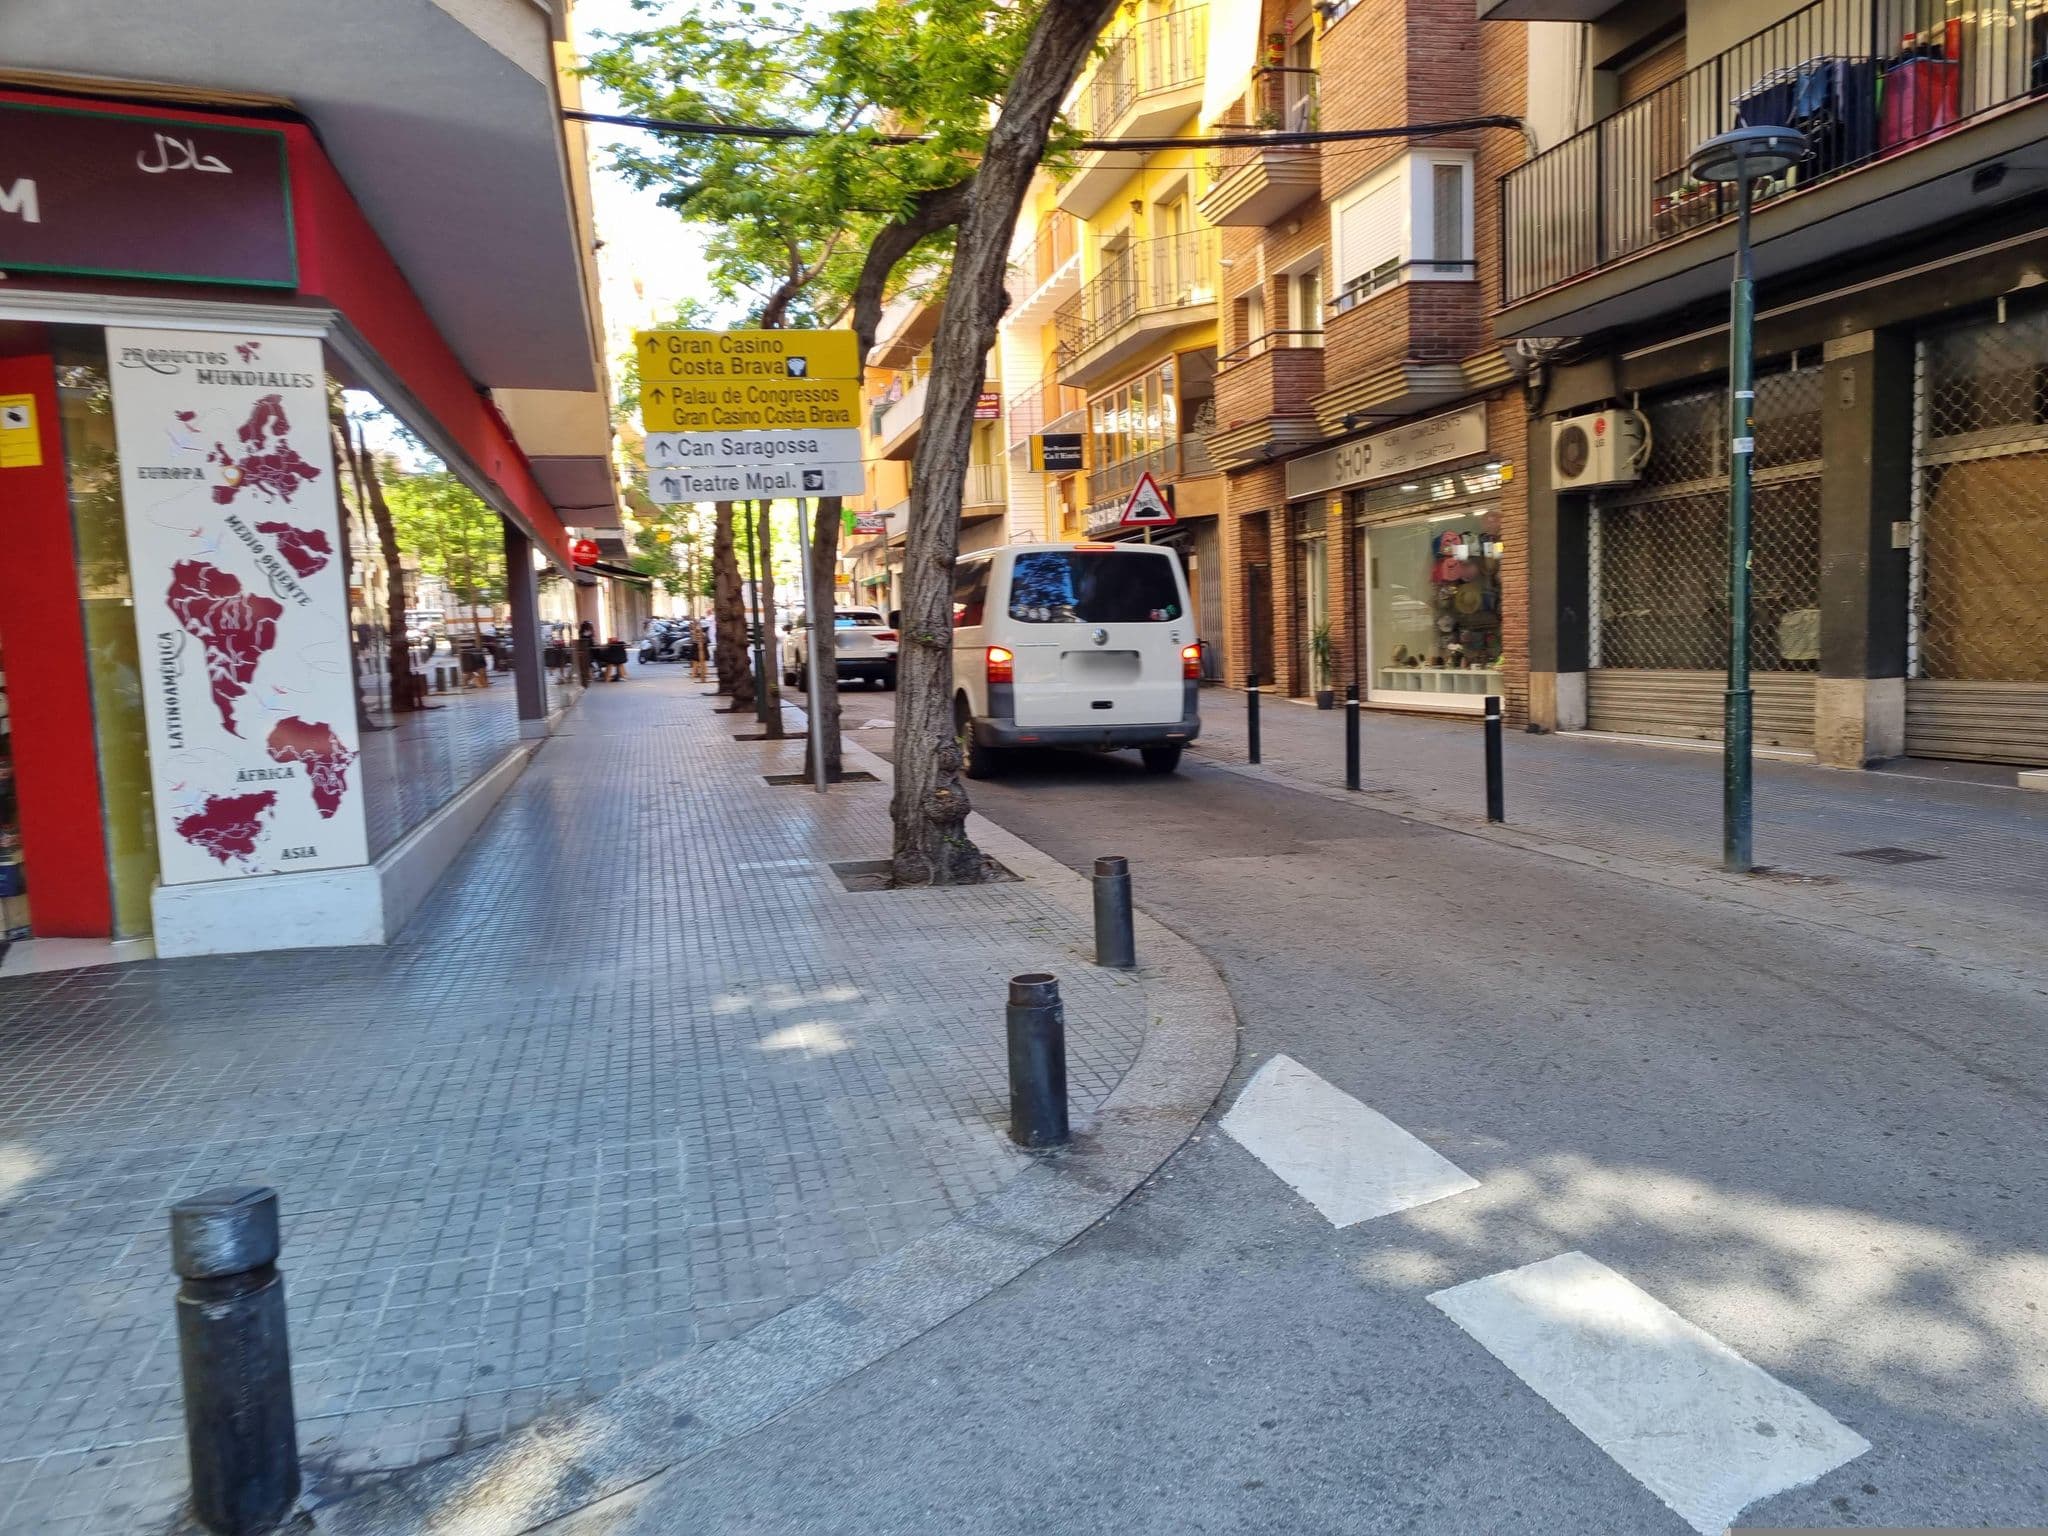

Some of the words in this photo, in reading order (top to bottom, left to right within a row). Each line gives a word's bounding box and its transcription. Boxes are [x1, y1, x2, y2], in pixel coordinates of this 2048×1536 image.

[136, 132, 233, 174] حلال
[667, 336, 713, 353] Gran
[719, 336, 784, 353] Casino
[669, 357, 724, 375] Costa
[732, 357, 784, 374] Brava
[197, 368, 315, 388] MUNDIALES
[672, 387, 719, 404] Palau
[723, 387, 741, 404] de
[746, 385, 840, 407] Congressos
[673, 408, 708, 425] Gran
[711, 407, 761, 424] Casino
[764, 406, 806, 423] Costa
[811, 406, 849, 422] Brava
[678, 439, 715, 456] Can
[721, 438, 819, 458] Saragossa
[1335, 444, 1372, 481] SHOP
[137, 466, 206, 481] EUROPA
[682, 475, 740, 493] Teatre
[745, 472, 797, 494] Mpal.
[223, 513, 265, 555] MEDIO
[253, 553, 313, 607] ORIENTE
[281, 845, 318, 861] ASIA
